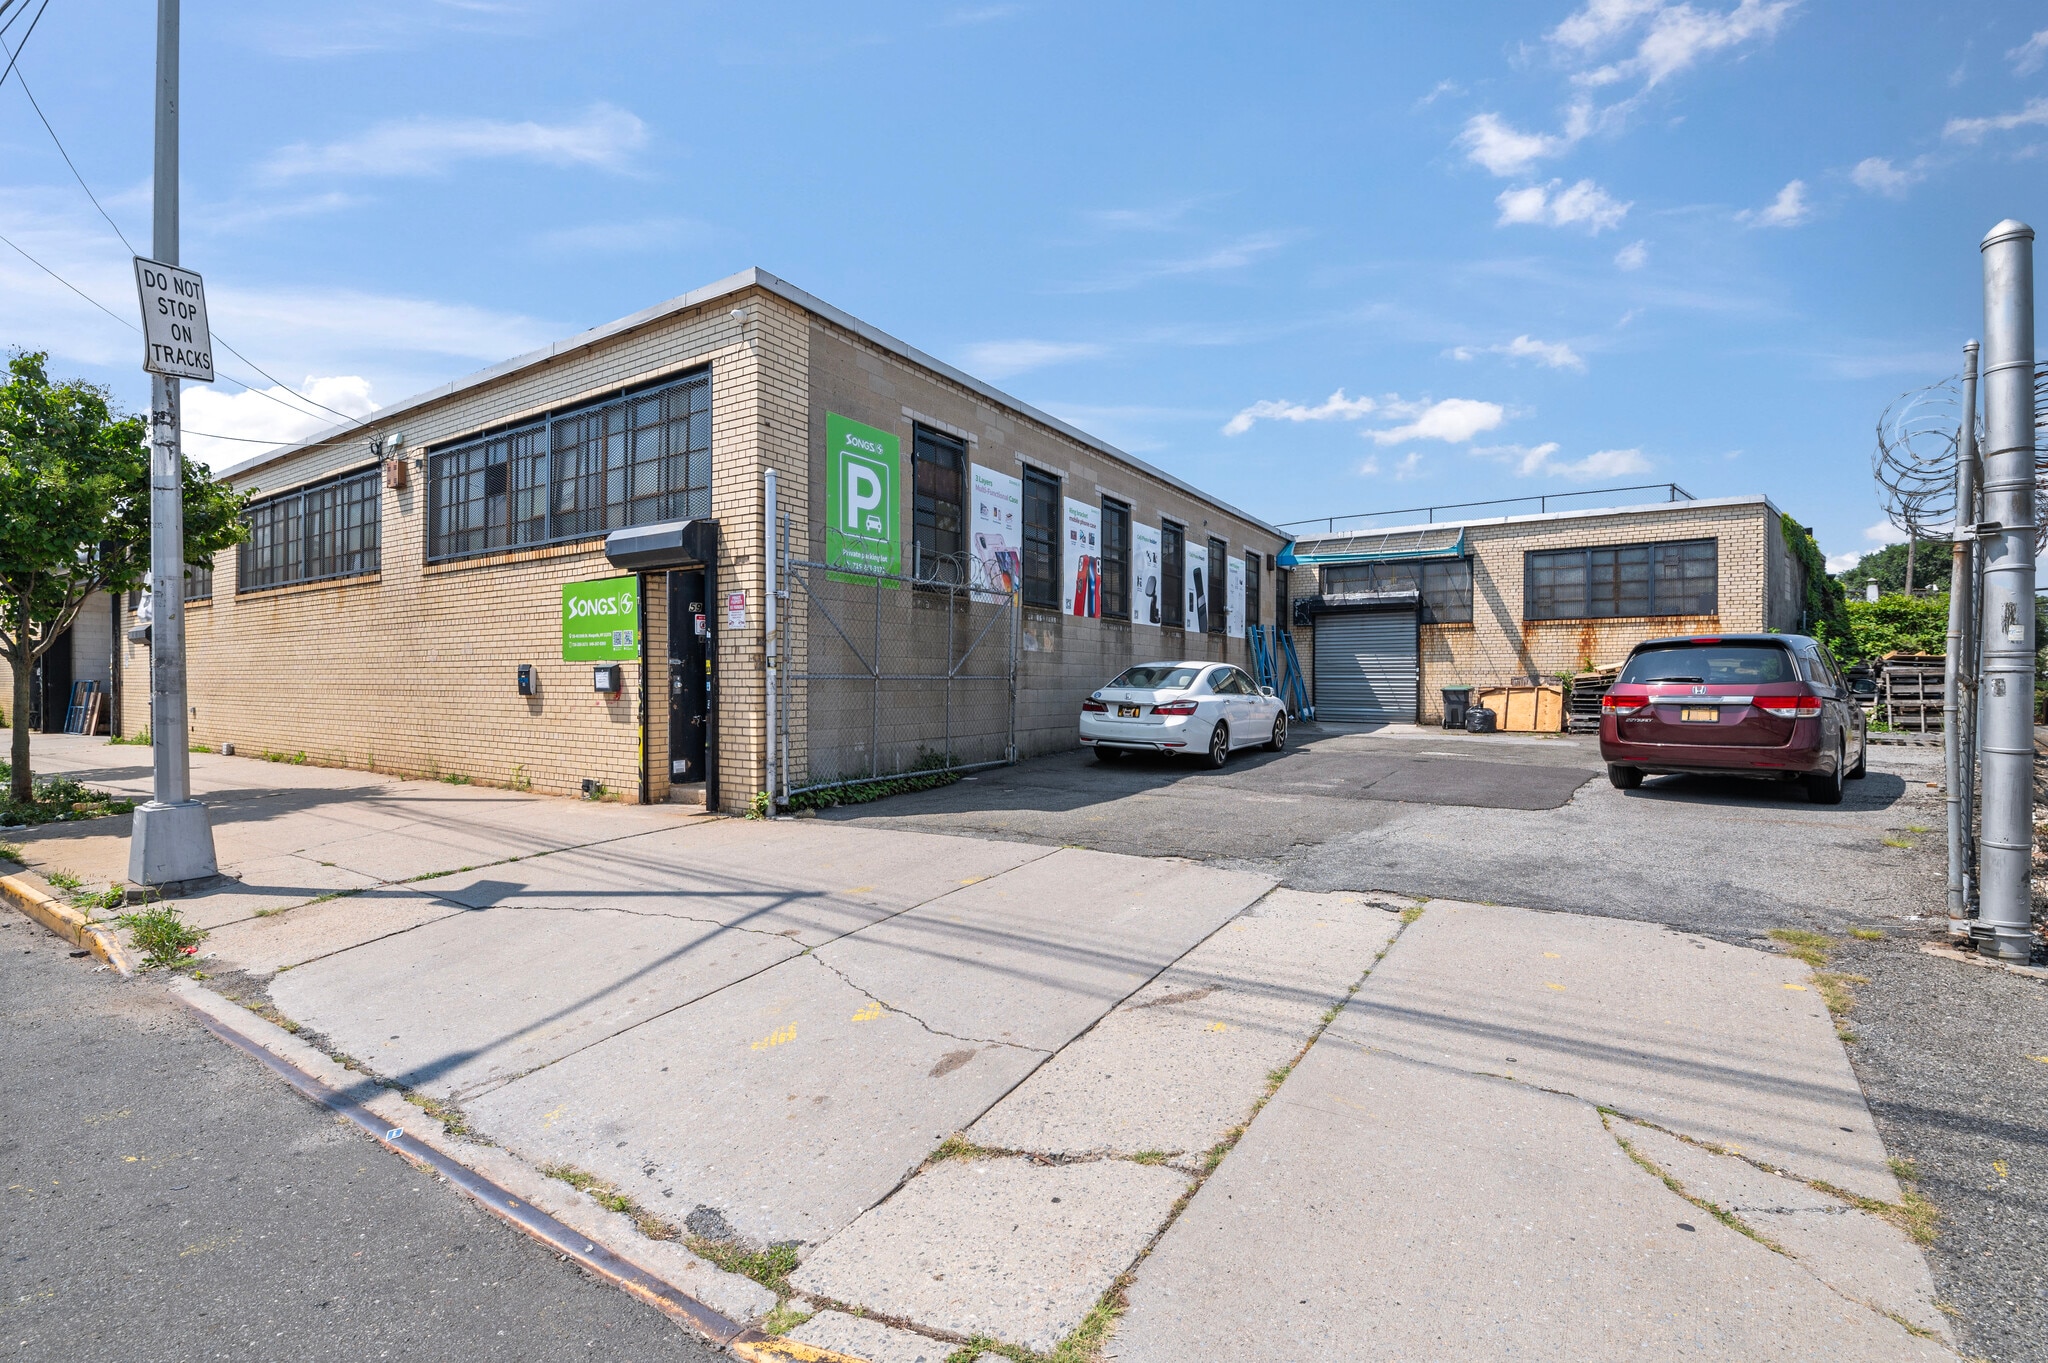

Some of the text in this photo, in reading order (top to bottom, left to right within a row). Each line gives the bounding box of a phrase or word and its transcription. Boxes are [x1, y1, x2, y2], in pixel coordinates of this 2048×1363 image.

[144, 269, 200, 300] DO NOT
[158, 297, 197, 321] STOP
[171, 323, 193, 344] ON
[152, 343, 211, 370] TRACKS
[845, 433, 875, 453] SONGS
[975, 474, 993, 487] 3 Layers
[848, 462, 882, 529] P
[975, 483, 1019, 505] Multi-Functional Case
[842, 548, 861, 559] Private
[568, 596, 618, 619] SONGS
